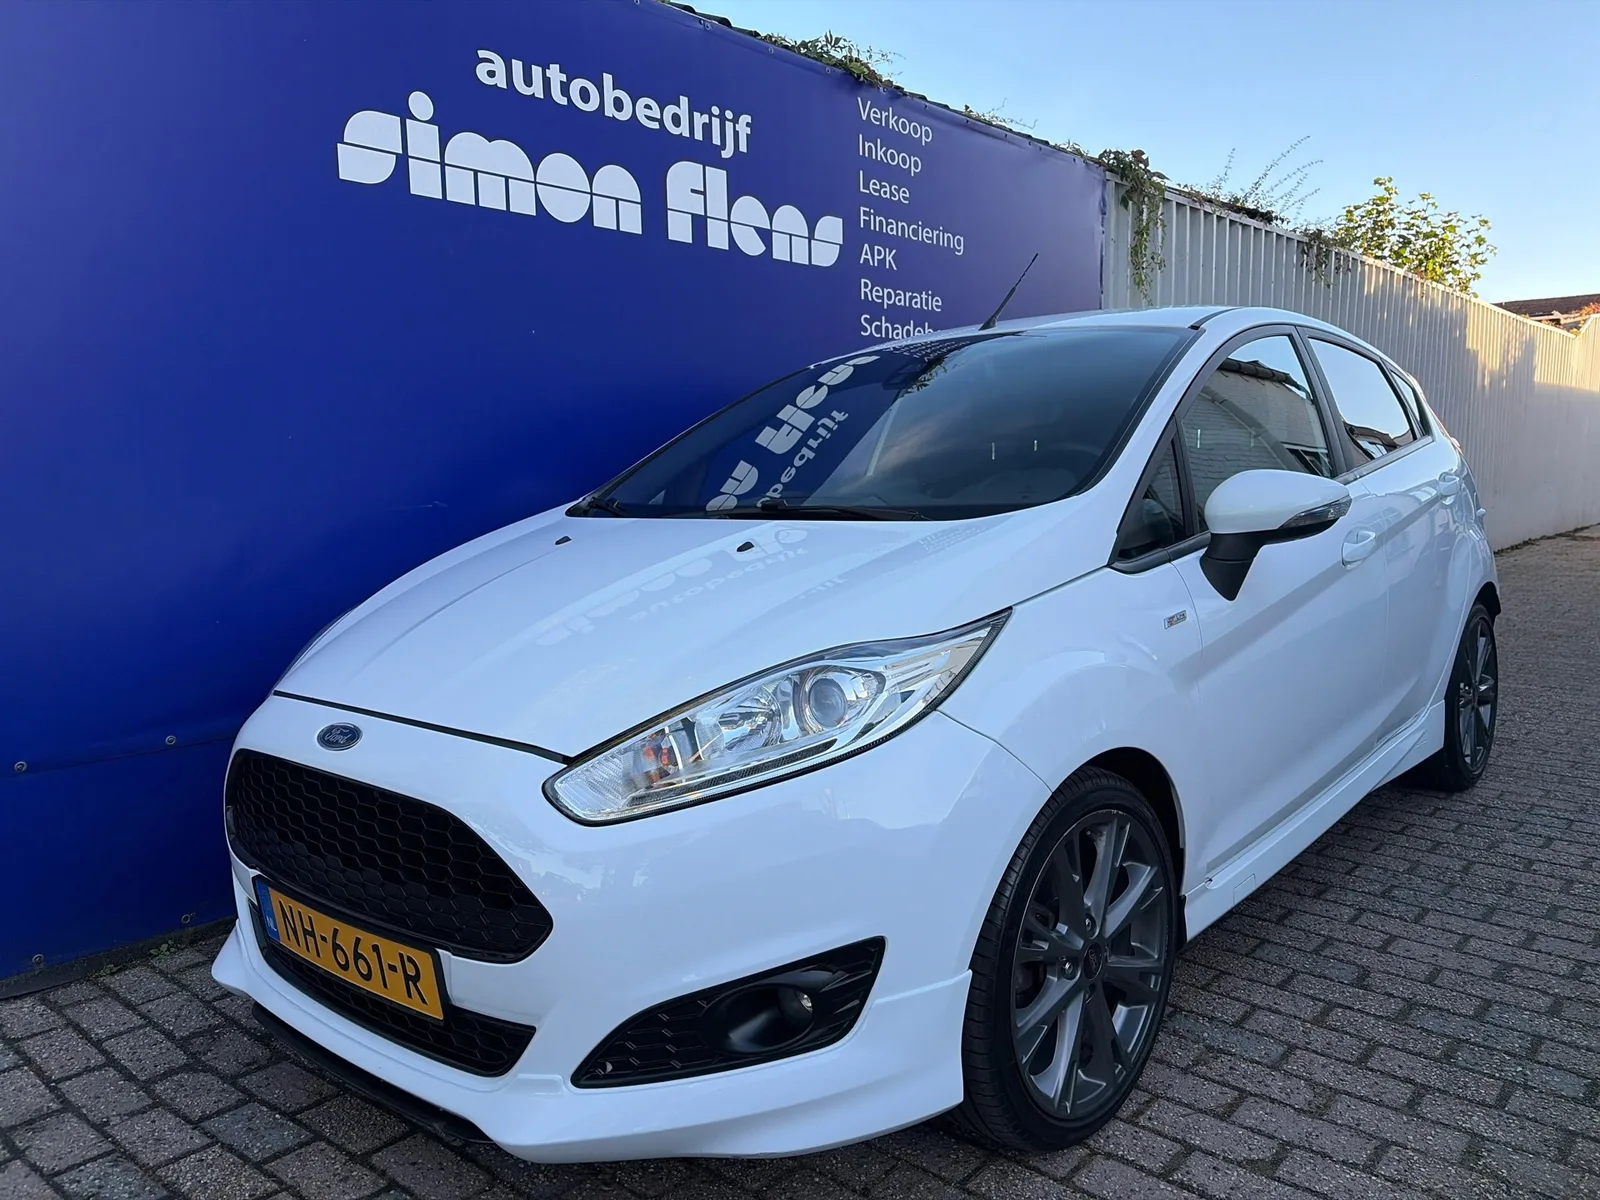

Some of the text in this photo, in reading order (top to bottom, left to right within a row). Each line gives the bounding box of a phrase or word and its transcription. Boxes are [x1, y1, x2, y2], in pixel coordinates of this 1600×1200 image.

[476, 49, 752, 158] autobedrijf
[857, 97, 932, 146] Verkoop
[337, 91, 642, 234] simon
[859, 134, 922, 176] Inkoop
[859, 170, 909, 203] Lease
[860, 206, 964, 255] Financiering
[860, 243, 897, 270] APK
[861, 278, 942, 312] Reparatie
[278, 899, 428, 1006] NH-661-R
